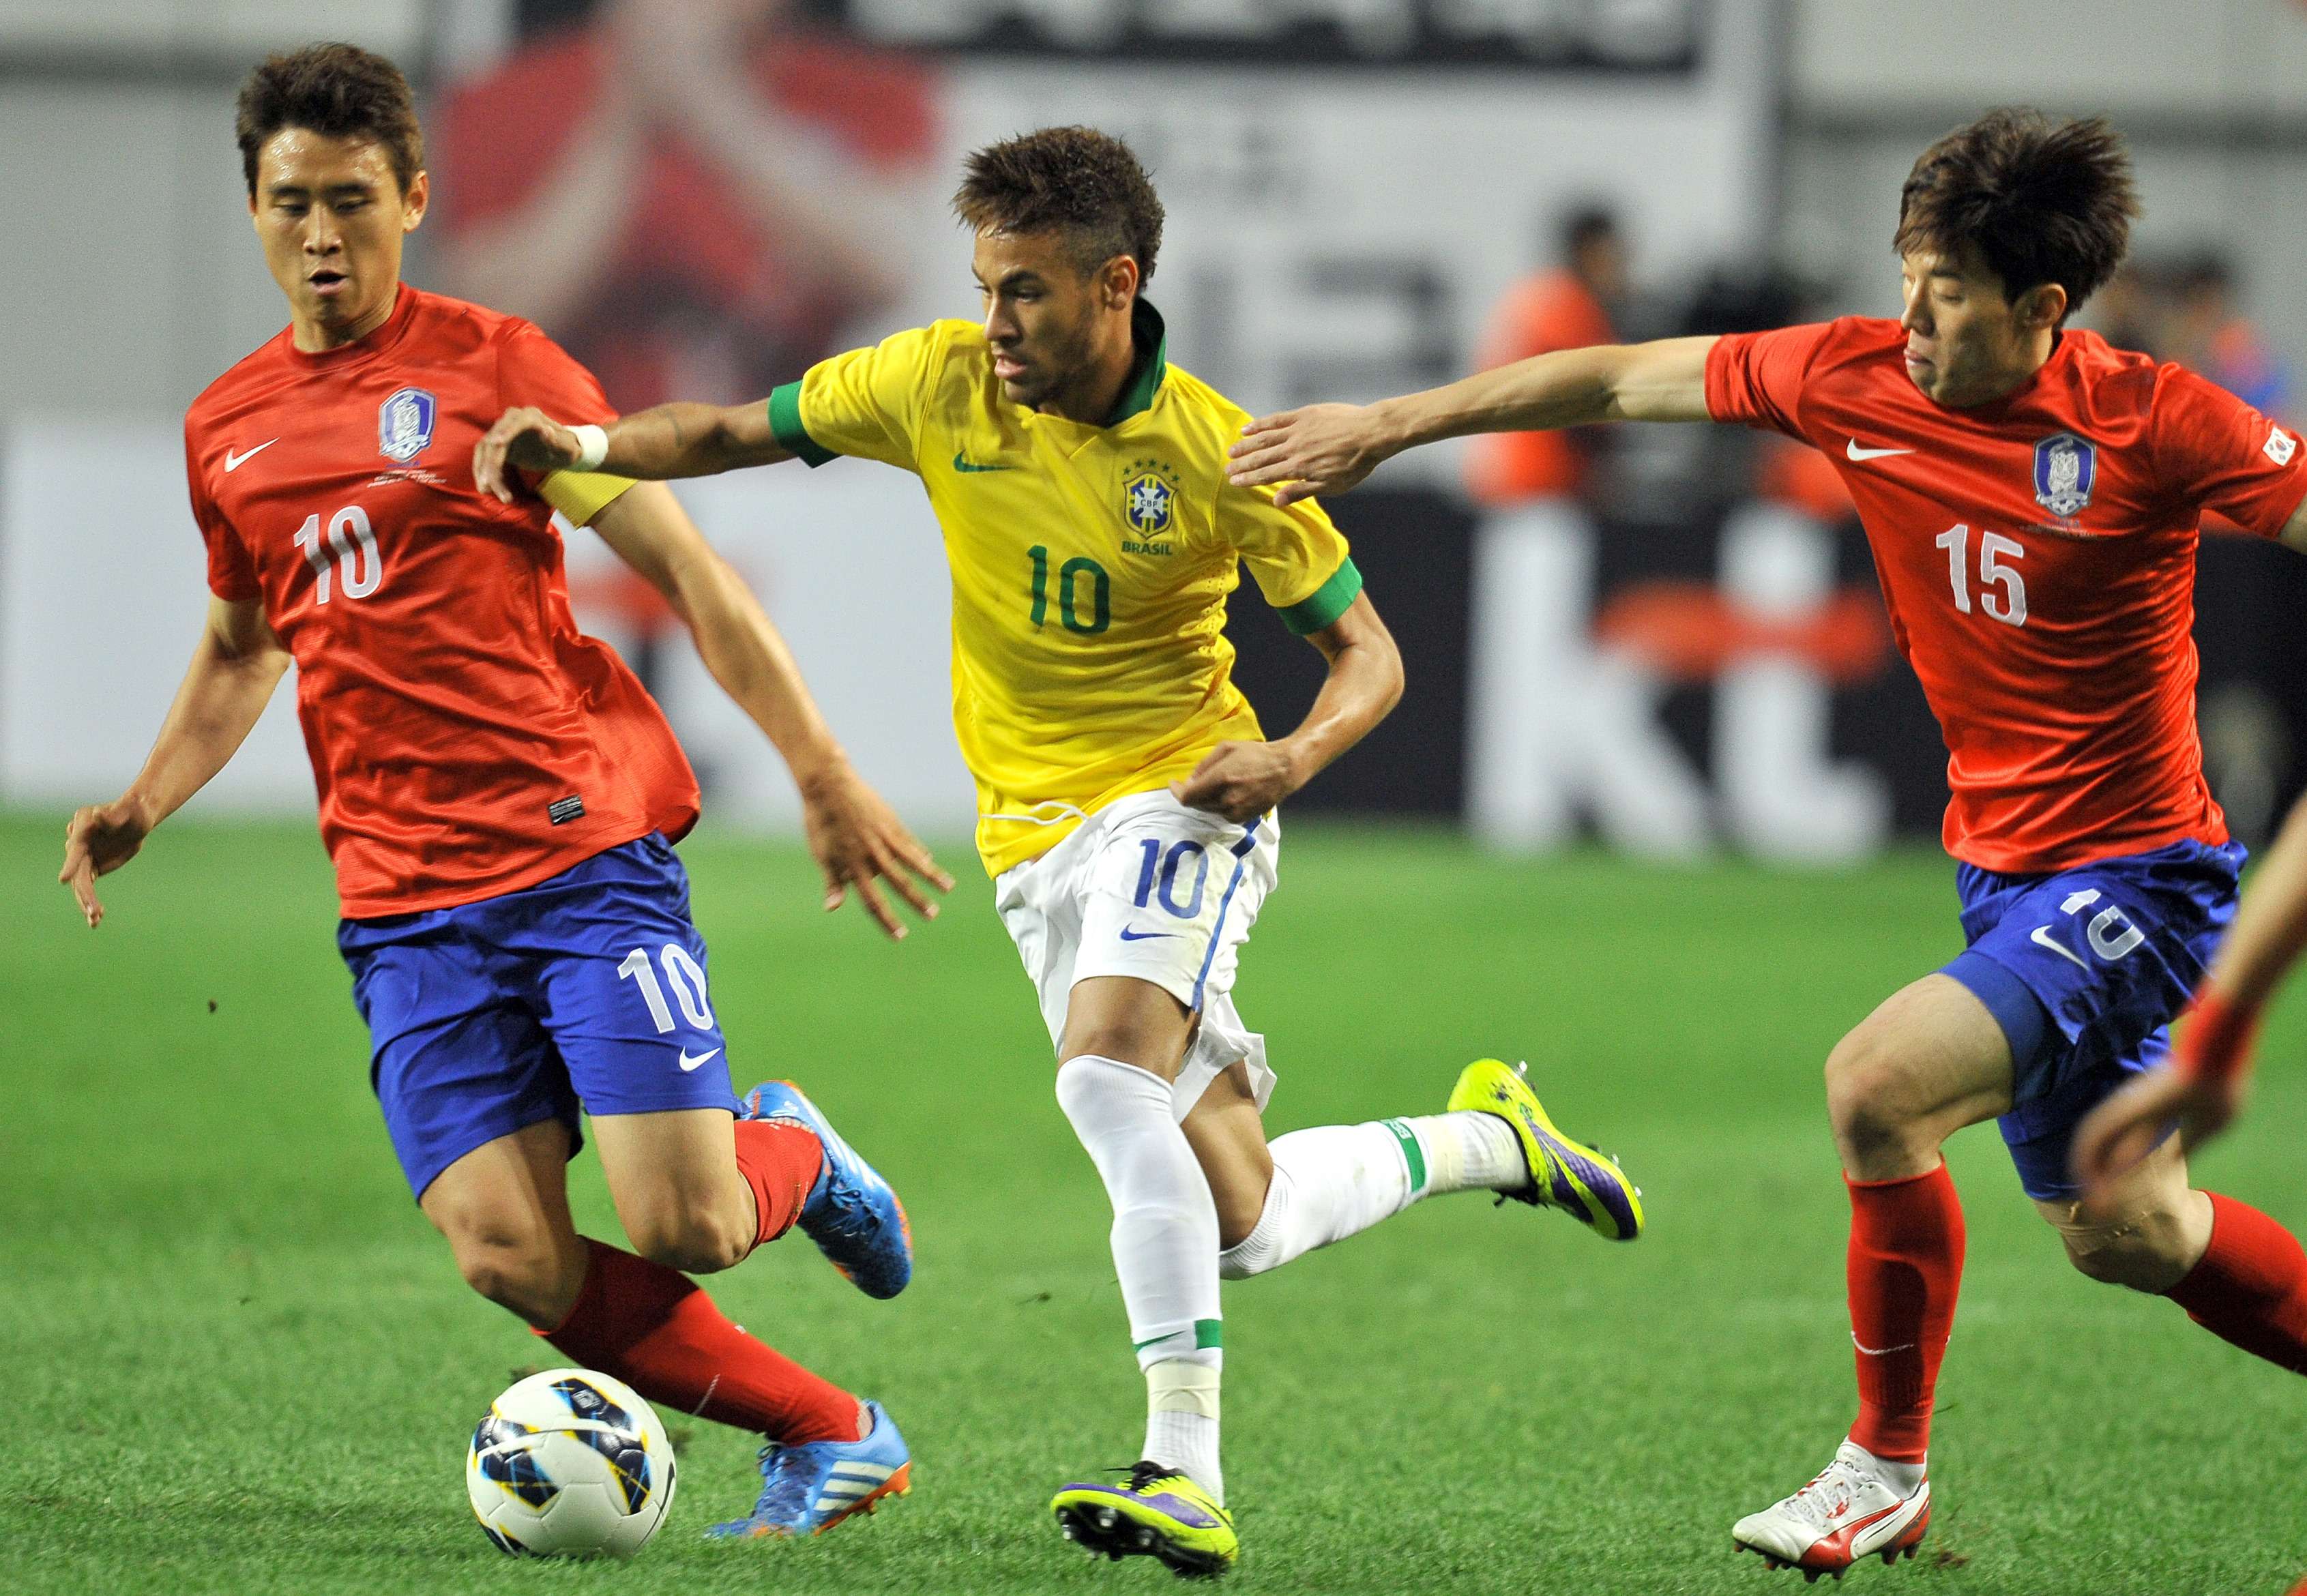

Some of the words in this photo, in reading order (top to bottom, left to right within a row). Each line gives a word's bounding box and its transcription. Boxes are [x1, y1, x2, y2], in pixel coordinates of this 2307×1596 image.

[1140, 499, 1158, 507] CBF
[293, 505, 383, 606] 10
[1027, 545, 1110, 634] 10
[1121, 540, 1172, 556] BRASIL
[1935, 523, 2027, 627] 15
[1133, 839, 1209, 919] 10
[617, 943, 714, 1034] 10
